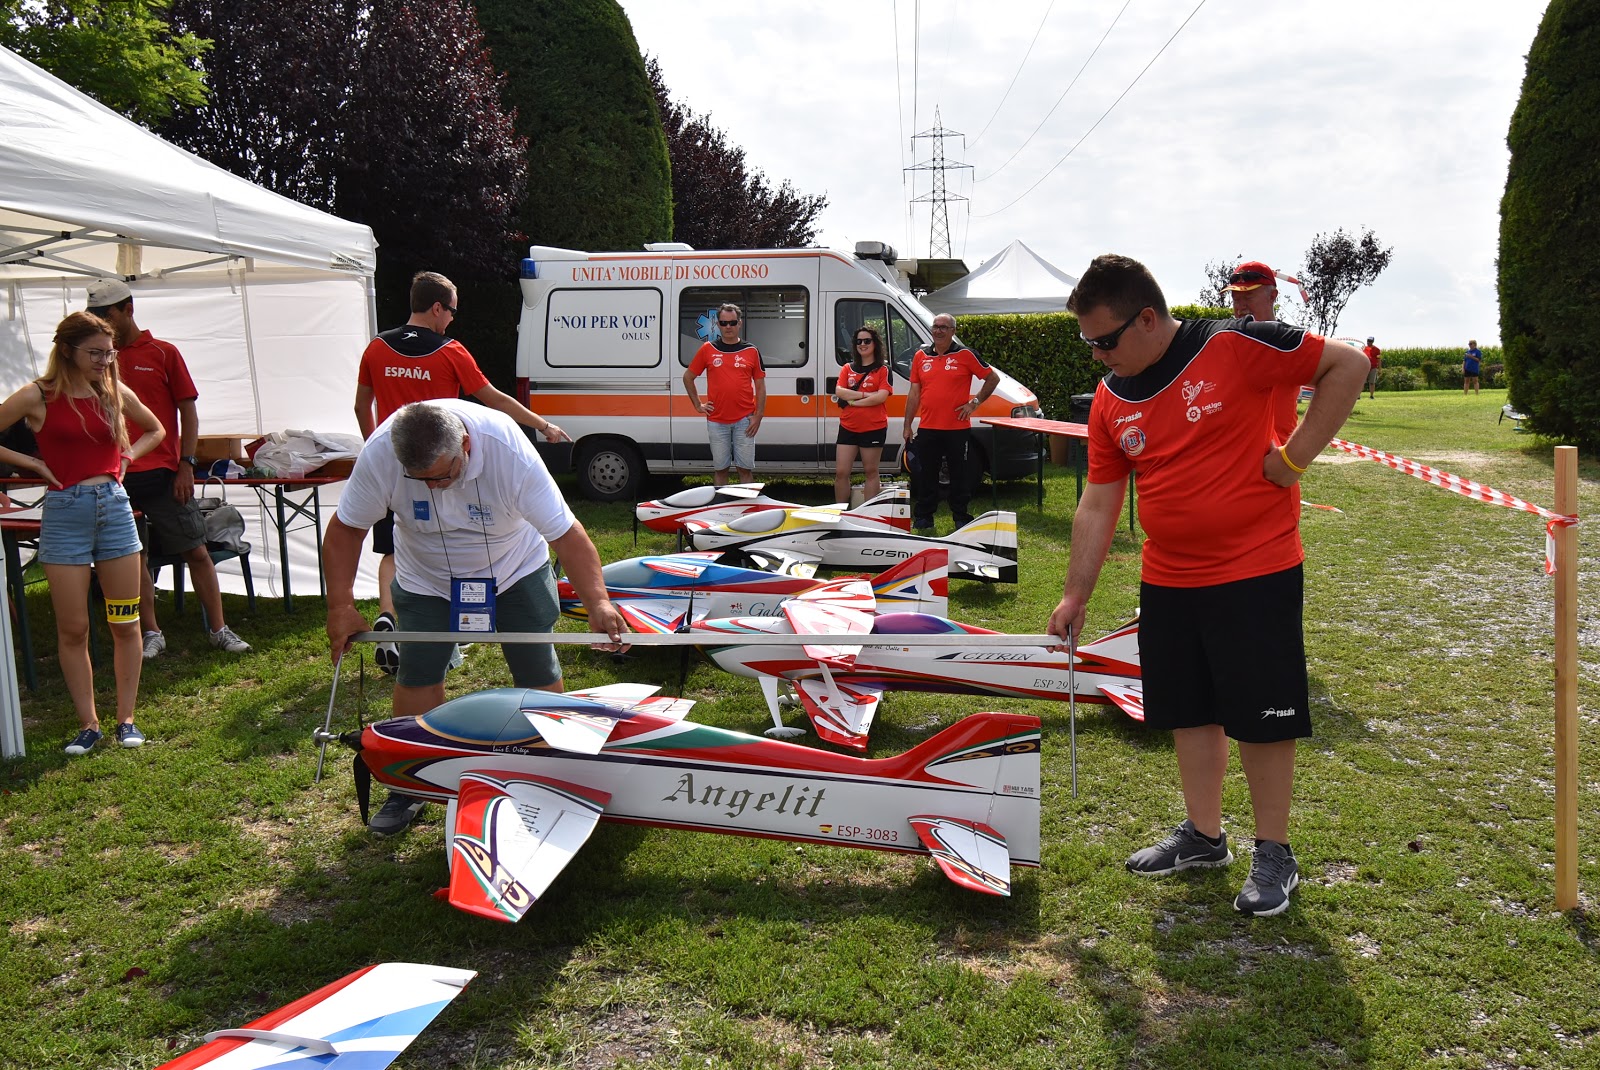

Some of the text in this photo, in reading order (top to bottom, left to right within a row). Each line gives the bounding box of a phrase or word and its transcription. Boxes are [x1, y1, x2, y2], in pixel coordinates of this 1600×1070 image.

[618, 266, 671, 280] MOBILE
[675, 265, 689, 279] DI
[693, 264, 769, 279] SOCCORSO
[591, 315, 619, 329] PER
[621, 332, 650, 341] ONLUS
[384, 366, 431, 381] ESPAÑA
[107, 603, 140, 616] STAF
[963, 652, 1036, 661] CITRIN
[1033, 678, 1080, 691] ESP 294
[661, 772, 826, 819] Angelit
[837, 824, 899, 842] ESP-3083
